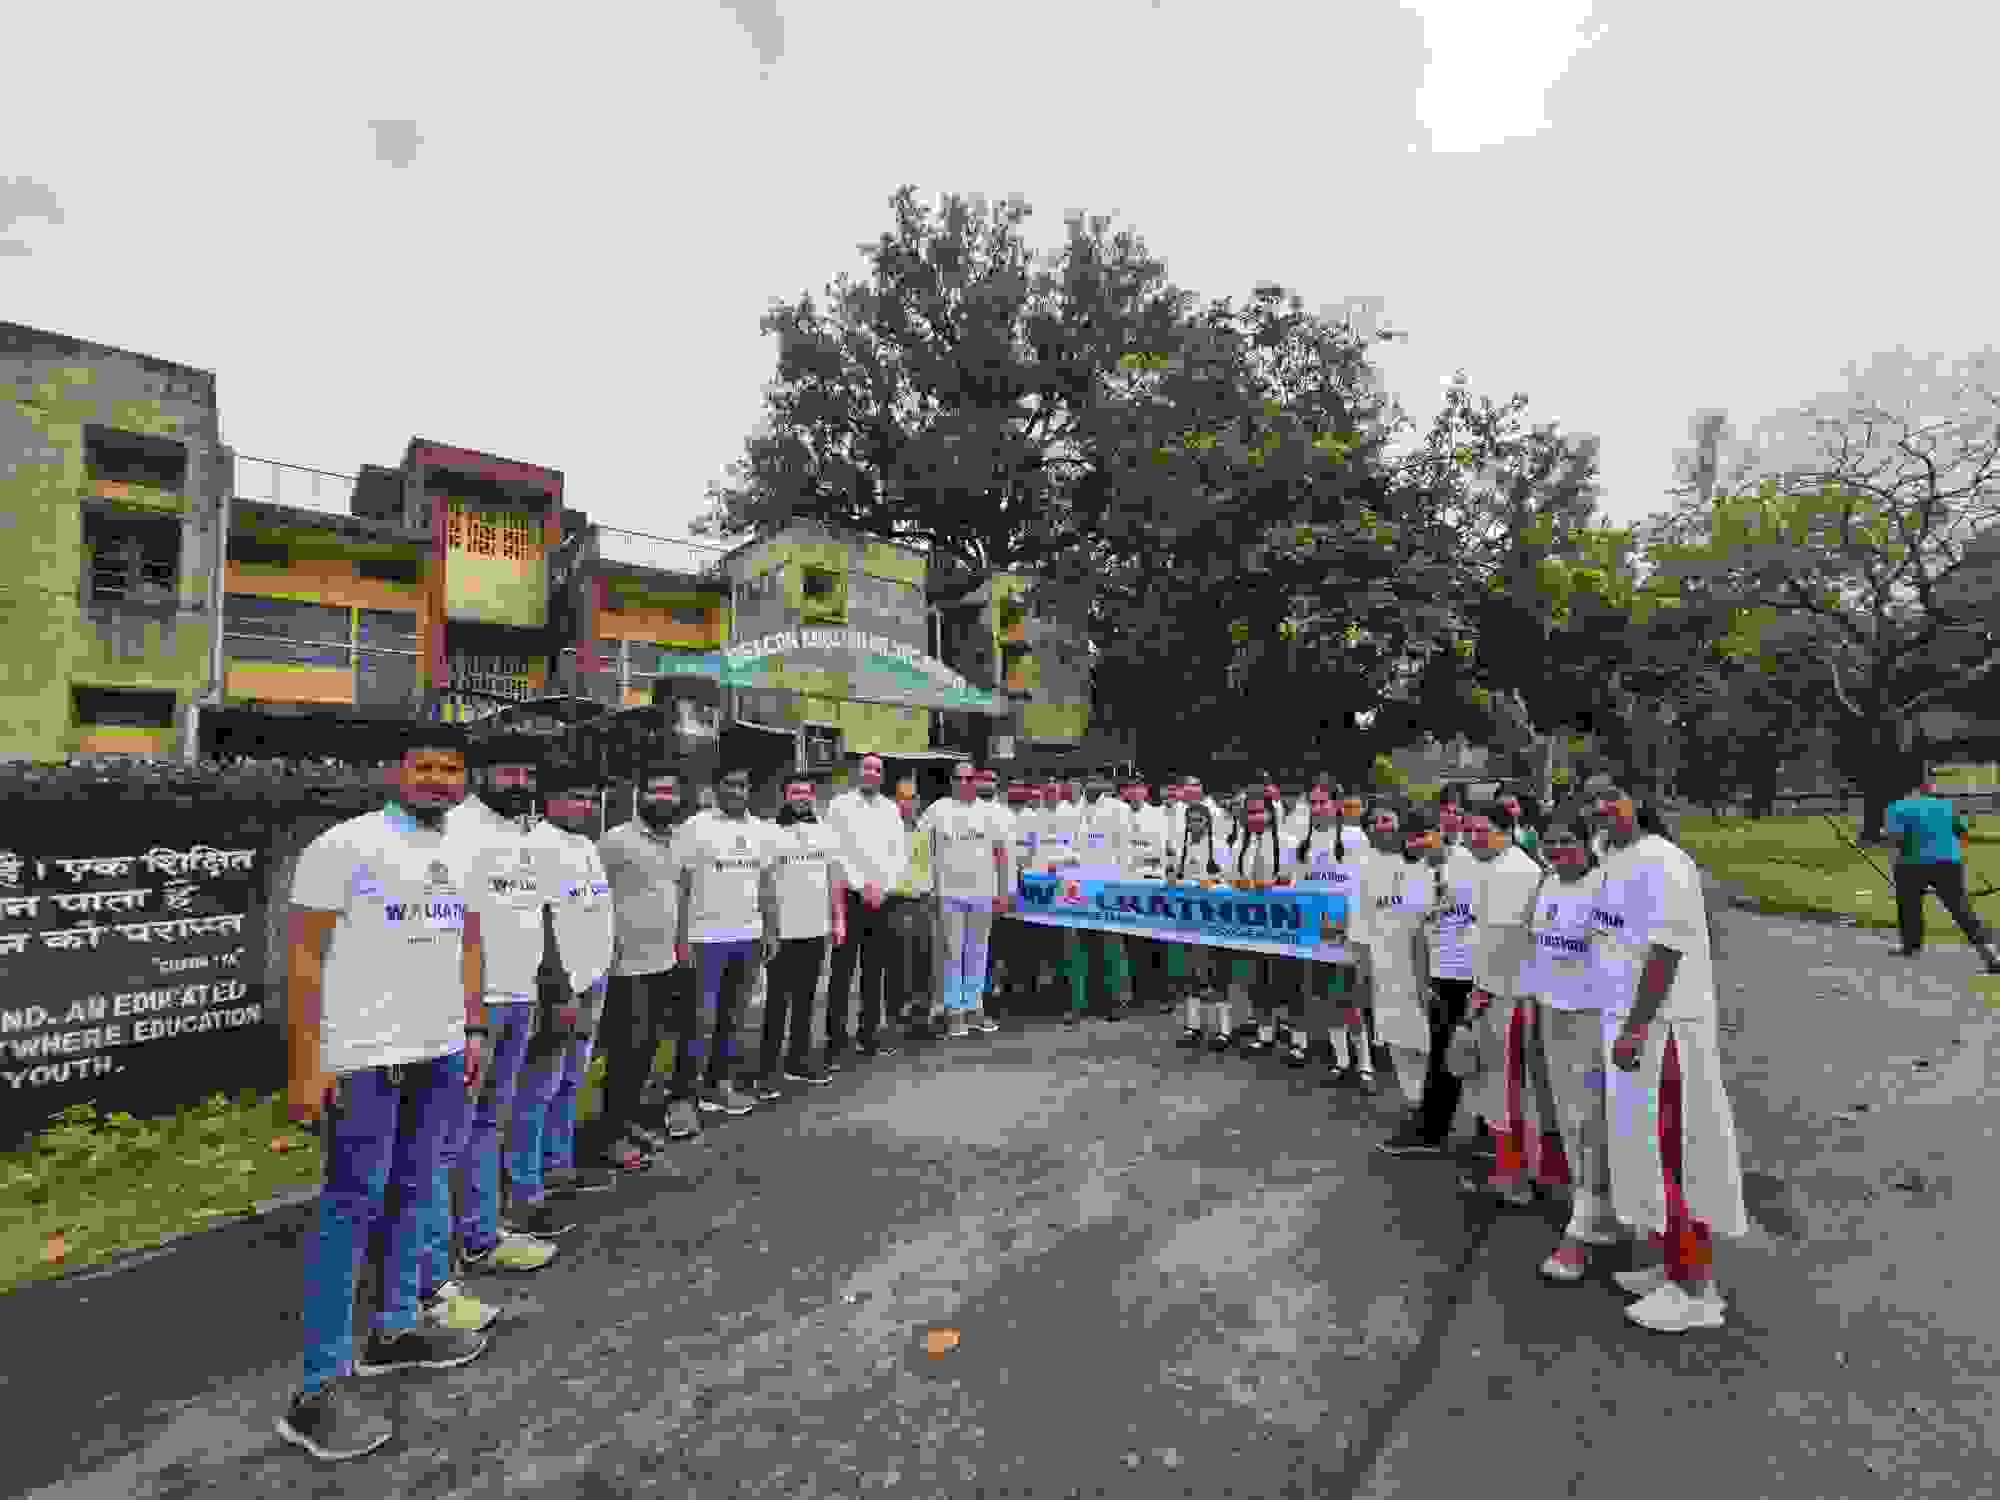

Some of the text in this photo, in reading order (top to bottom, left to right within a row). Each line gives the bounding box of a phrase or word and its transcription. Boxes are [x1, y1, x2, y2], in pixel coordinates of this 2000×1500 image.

[56, 856, 136, 882] एक
[138, 845, 256, 876] शिक्षित
[113, 979, 248, 1017] EDUCATED
[134, 1003, 262, 1042] EDUCATION
[3, 1054, 126, 1088] YOUTH.
